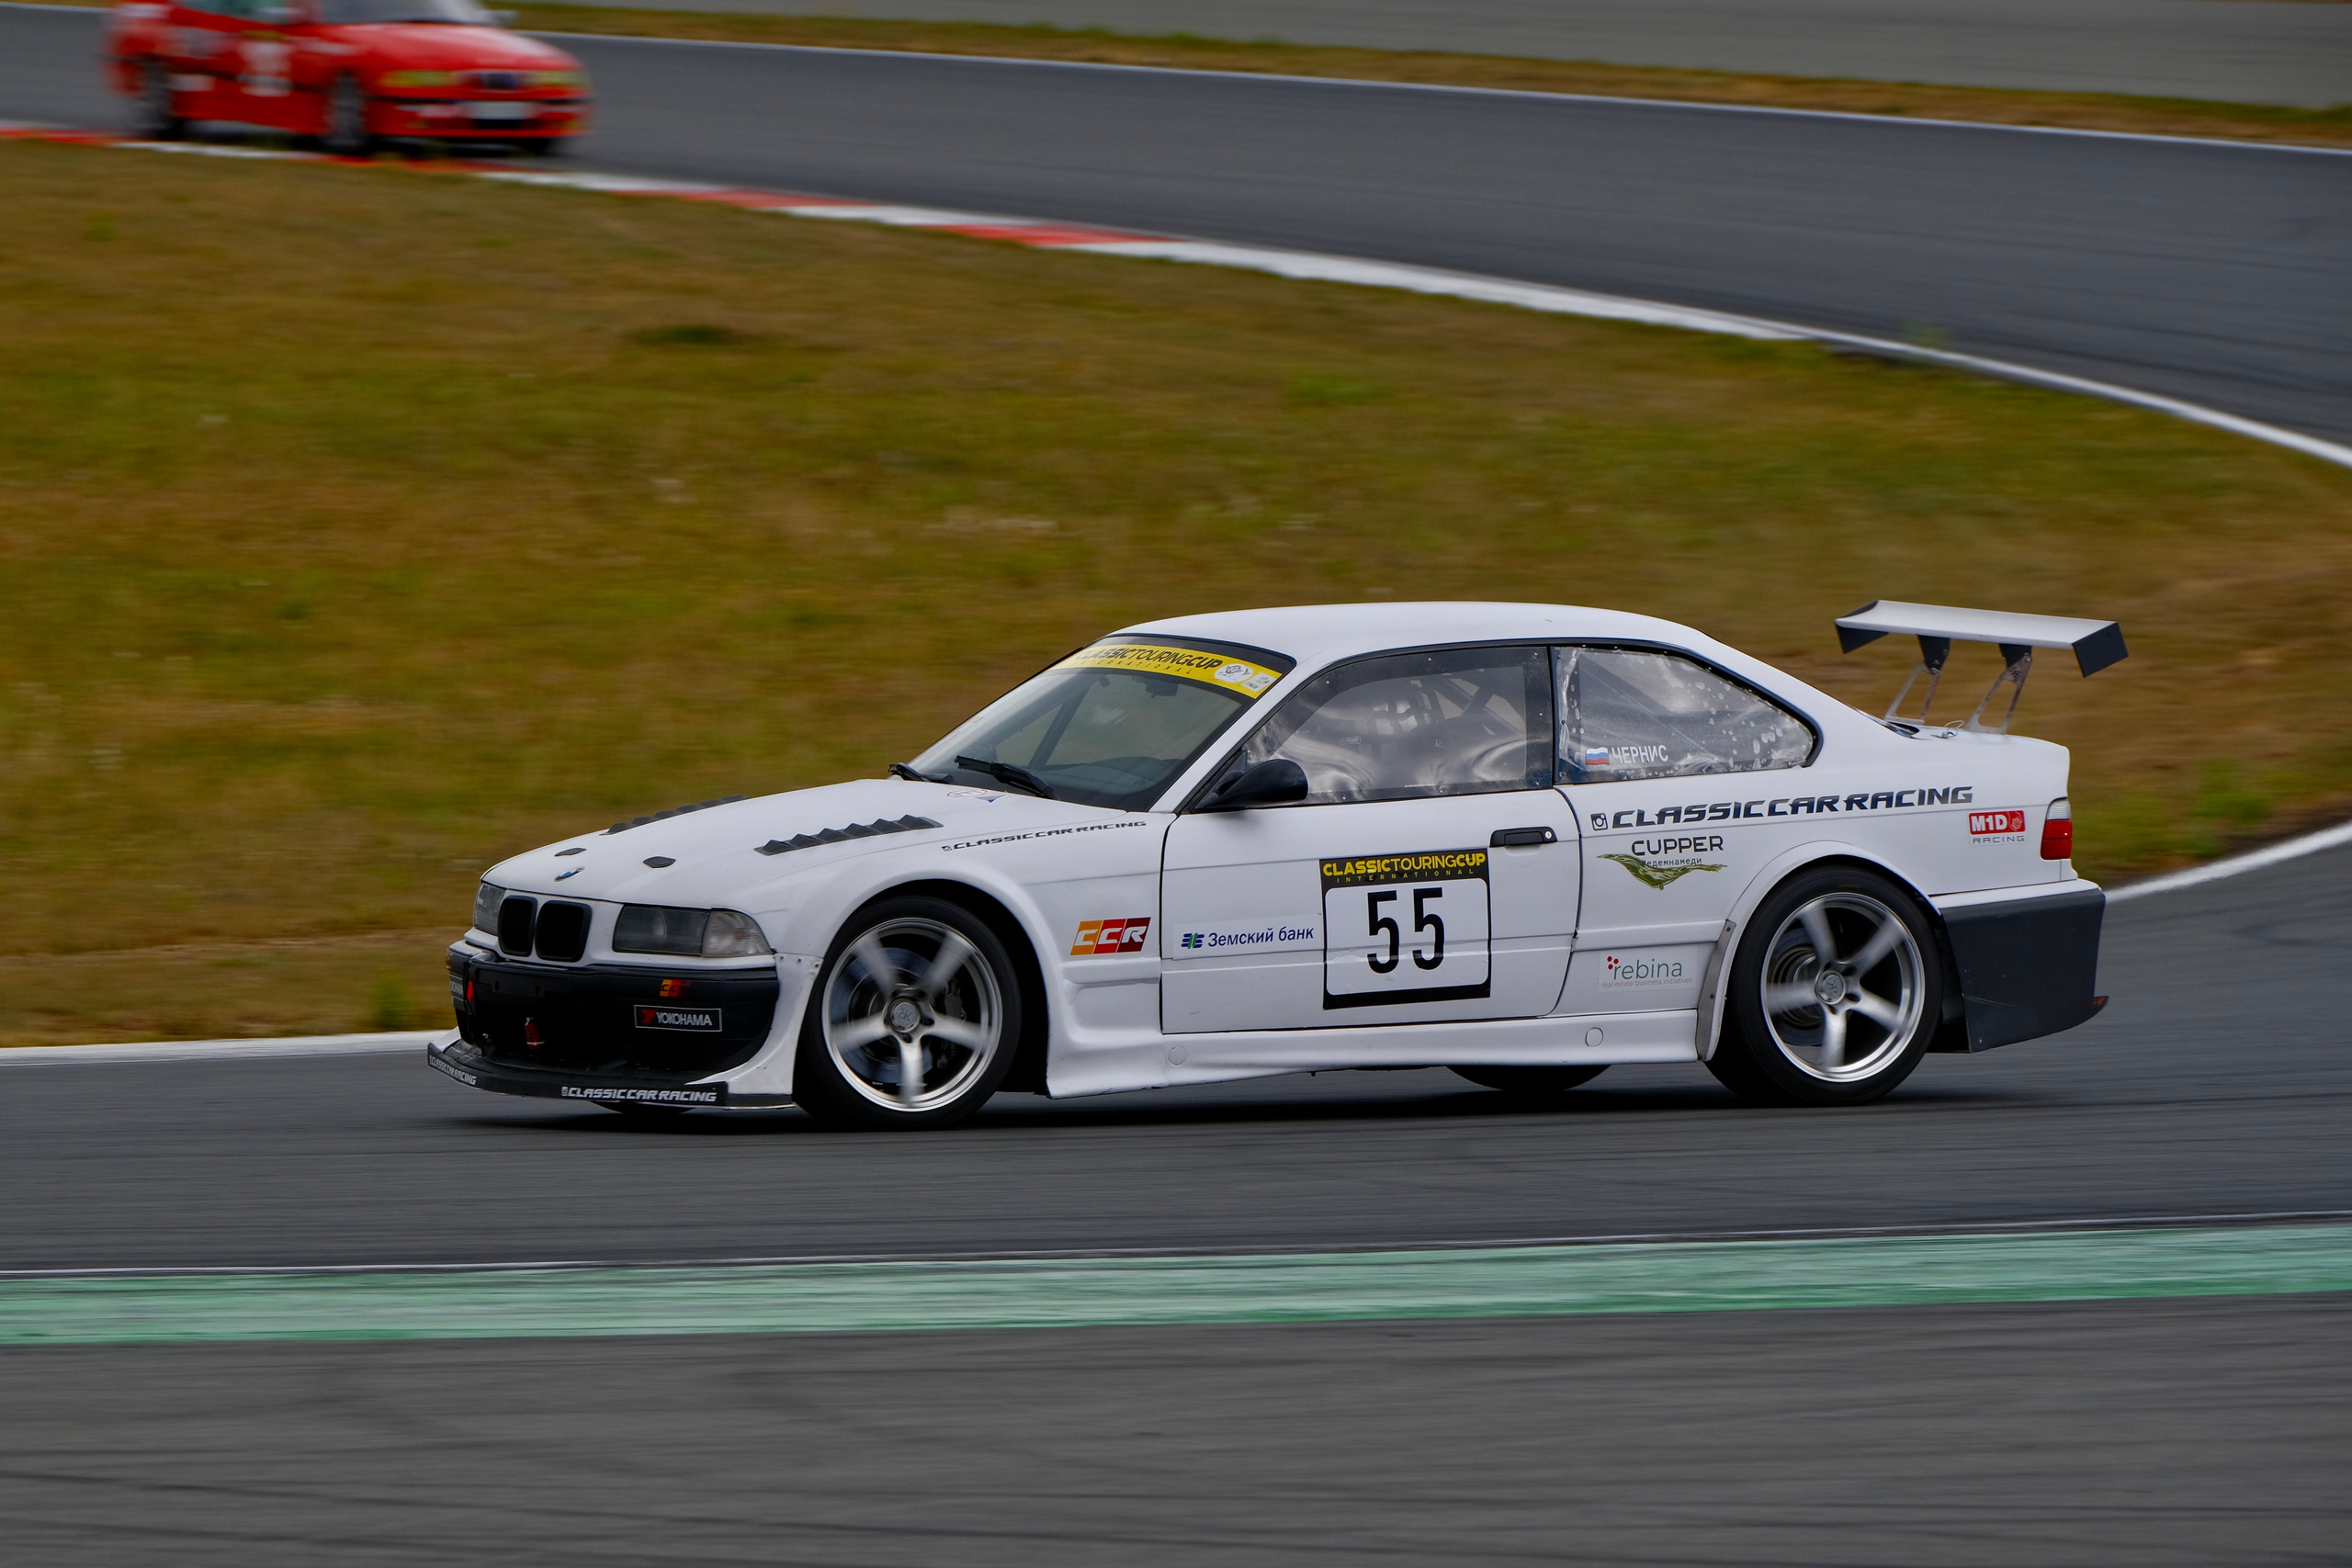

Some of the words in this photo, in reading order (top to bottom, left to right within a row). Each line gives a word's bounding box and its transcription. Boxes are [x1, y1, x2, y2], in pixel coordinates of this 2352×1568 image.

[1611, 744, 1668, 764] ЧЕРНИС
[1971, 814, 2007, 832] M1D
[1631, 835, 1724, 856] CUPPER
[1973, 835, 2025, 844] RACING
[1337, 868, 1474, 884] INTERNATIONAL
[1073, 926, 1148, 946] CCR
[1207, 928, 1273, 947] Земский
[1278, 926, 1315, 942] банк
[1366, 886, 1445, 974] 55
[1613, 958, 1682, 980] rebina
[656, 1011, 713, 1026] YOKOHAMA
